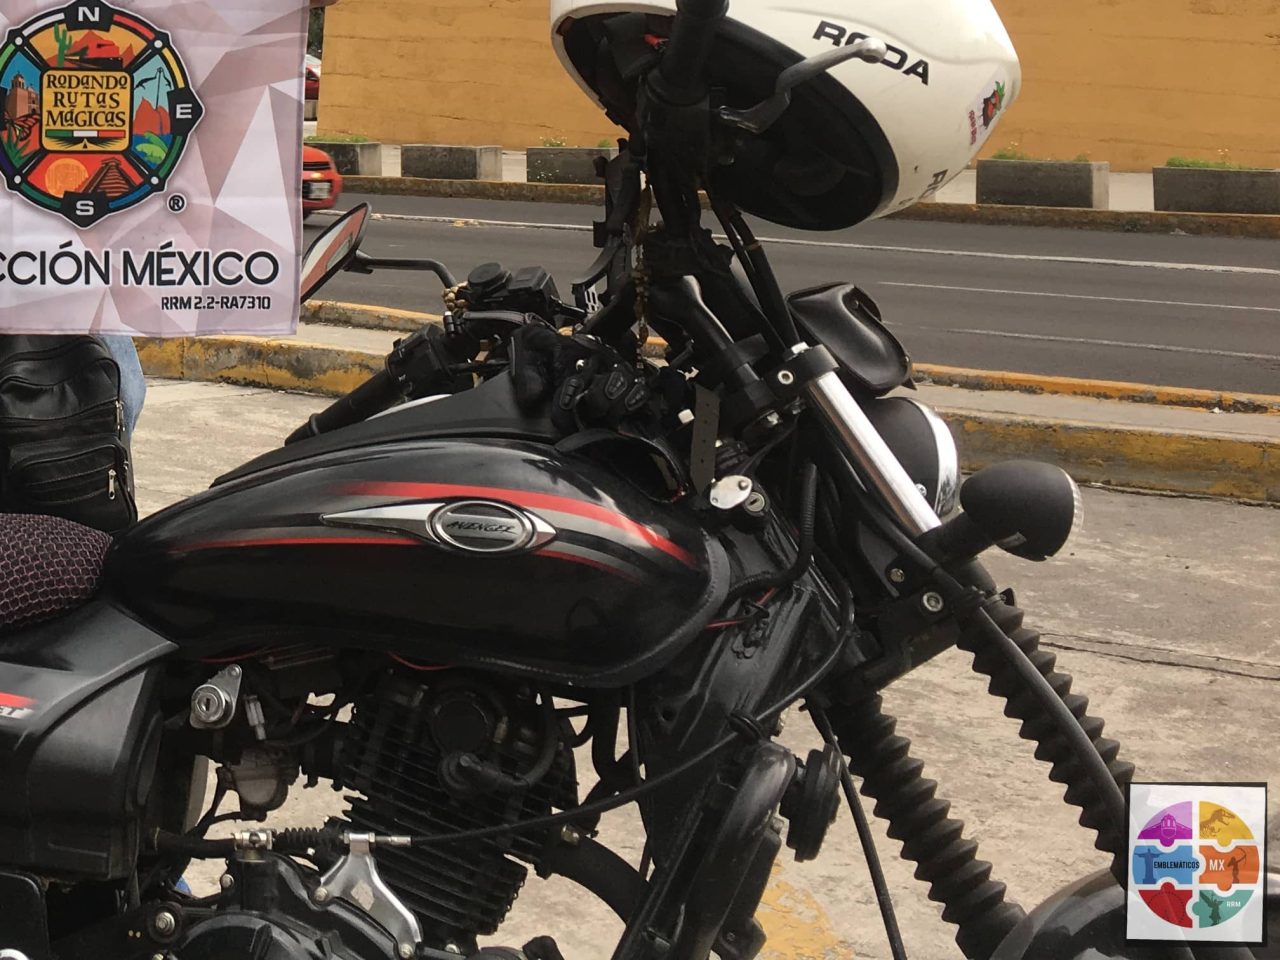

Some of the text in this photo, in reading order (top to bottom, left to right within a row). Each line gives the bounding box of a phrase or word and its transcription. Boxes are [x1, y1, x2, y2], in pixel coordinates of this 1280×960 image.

[78, 6, 100, 22] N
[176, 103, 193, 119] E
[76, 200, 95, 216] S
[122, 240, 279, 286] MÉXICO
[161, 296, 192, 310] RRM
